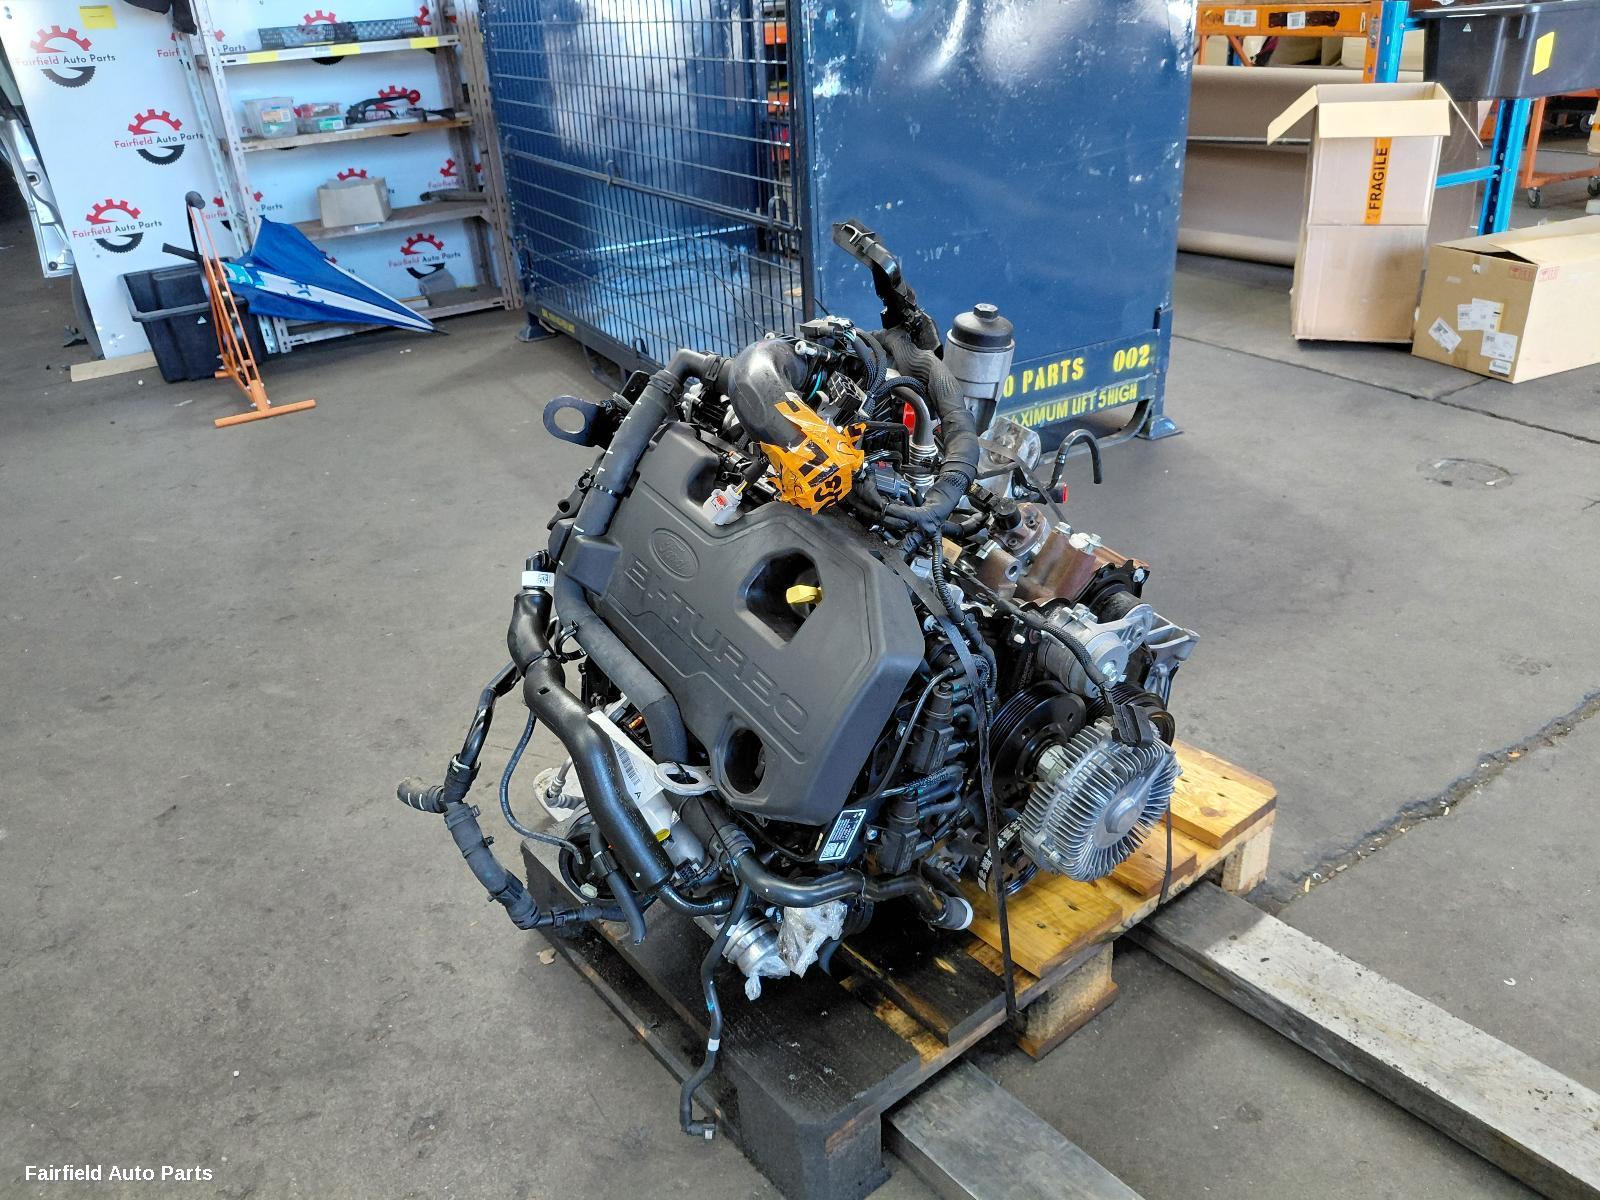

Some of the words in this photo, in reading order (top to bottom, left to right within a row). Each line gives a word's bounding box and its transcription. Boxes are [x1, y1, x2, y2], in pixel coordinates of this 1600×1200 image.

[63, 55, 87, 64] Auto
[89, 53, 116, 62] Parts
[114, 136, 153, 148] Fairfield
[156, 136, 178, 144] Auto
[180, 132, 204, 141] Parts
[1369, 147, 1388, 210] FRAGILE
[72, 225, 112, 238] Fairfield
[138, 220, 163, 229] Parts
[422, 255, 440, 263] Auto
[441, 251, 461, 259] Parts
[1022, 357, 1084, 394] PARTS
[1113, 344, 1150, 373] 002
[1071, 391, 1097, 416] LIFT
